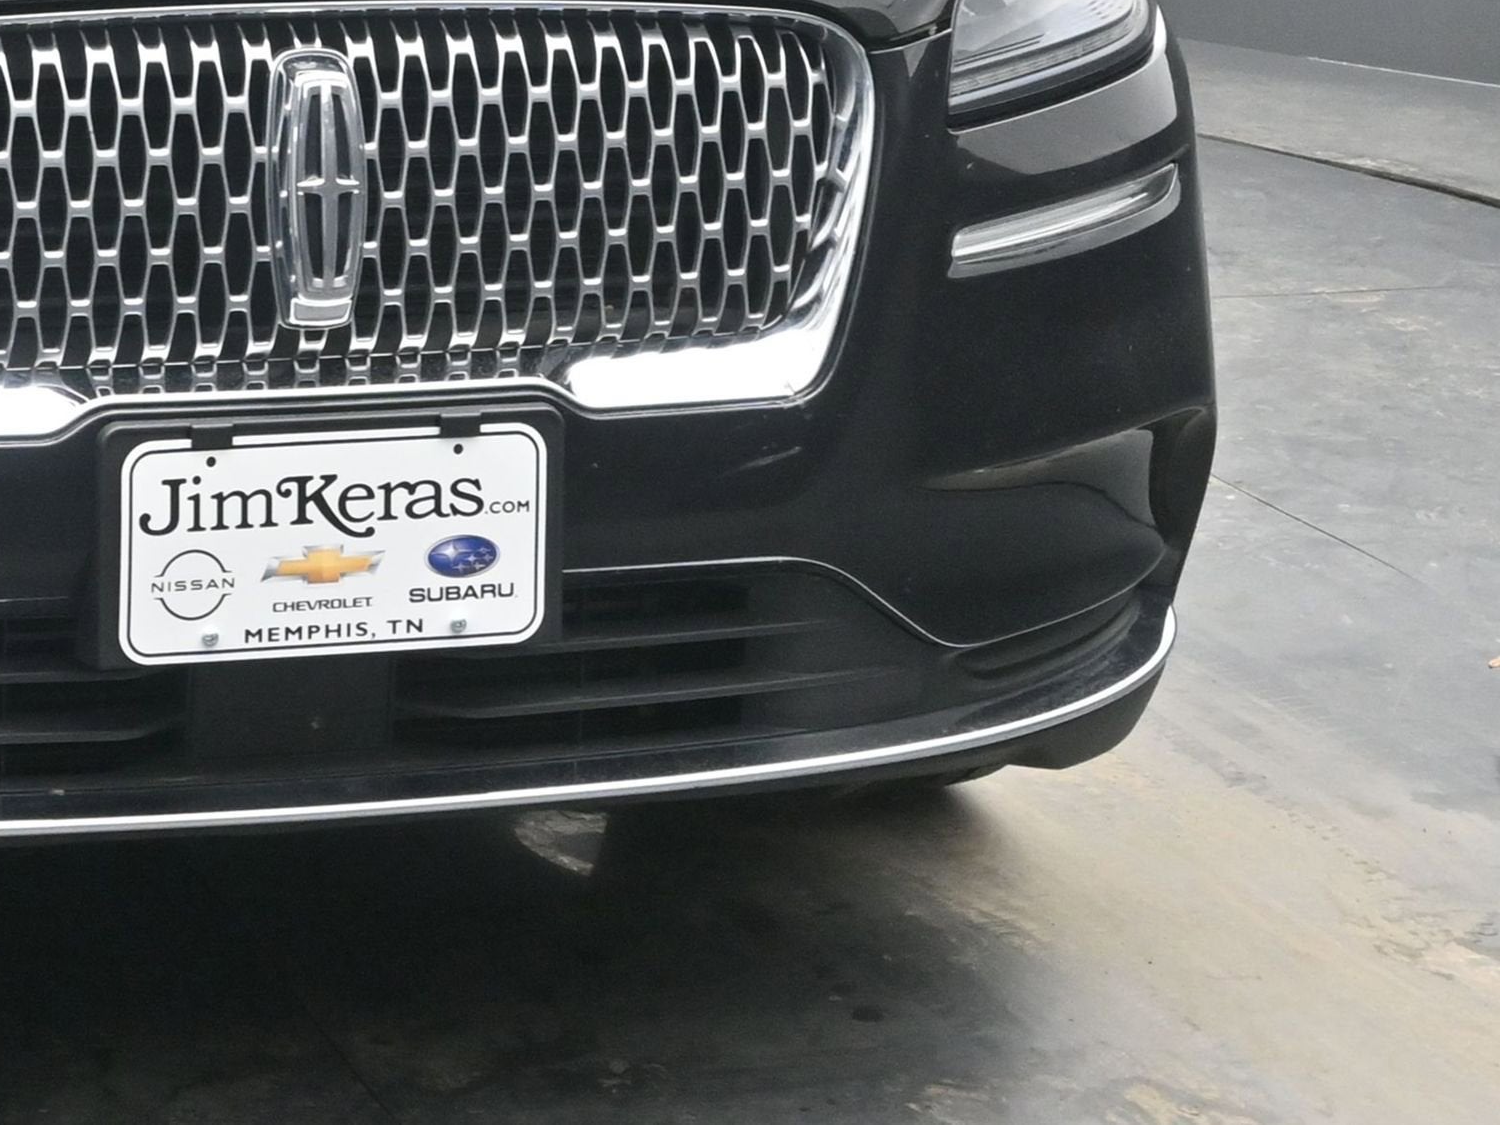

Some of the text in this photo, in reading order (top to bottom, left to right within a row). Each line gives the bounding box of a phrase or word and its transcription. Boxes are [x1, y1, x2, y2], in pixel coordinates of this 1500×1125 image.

[151, 577, 235, 593] NISSAN
[408, 582, 514, 603] SUBARU
[272, 596, 372, 613] CHEVROLET
[244, 618, 424, 644] MEMPHIS, TN
